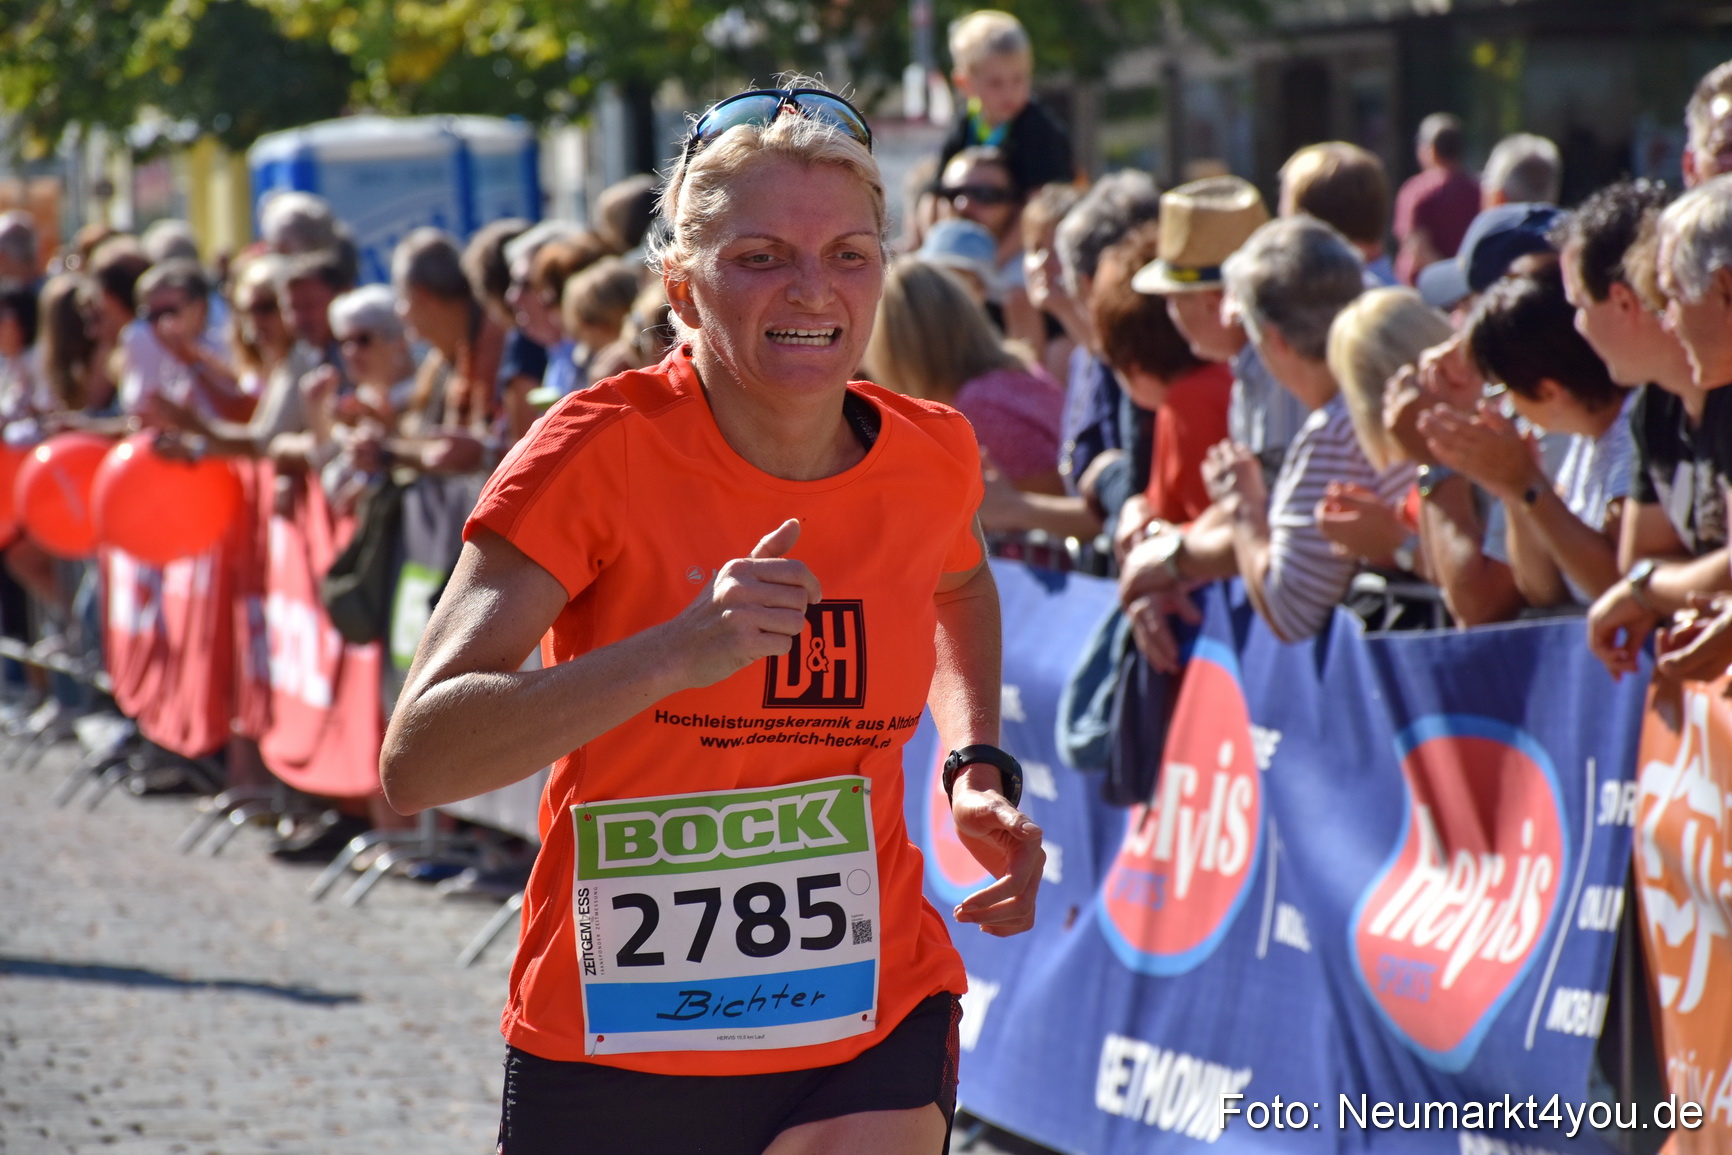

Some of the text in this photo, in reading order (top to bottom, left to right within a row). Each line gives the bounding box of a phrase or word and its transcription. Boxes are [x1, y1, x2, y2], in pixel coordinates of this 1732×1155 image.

[654, 709, 853, 731] Hochleistungskeramik
[855, 719, 885, 731] aus
[598, 790, 848, 868] BOCK
[611, 872, 847, 967] 2785
[1369, 802, 1555, 990] hervis
